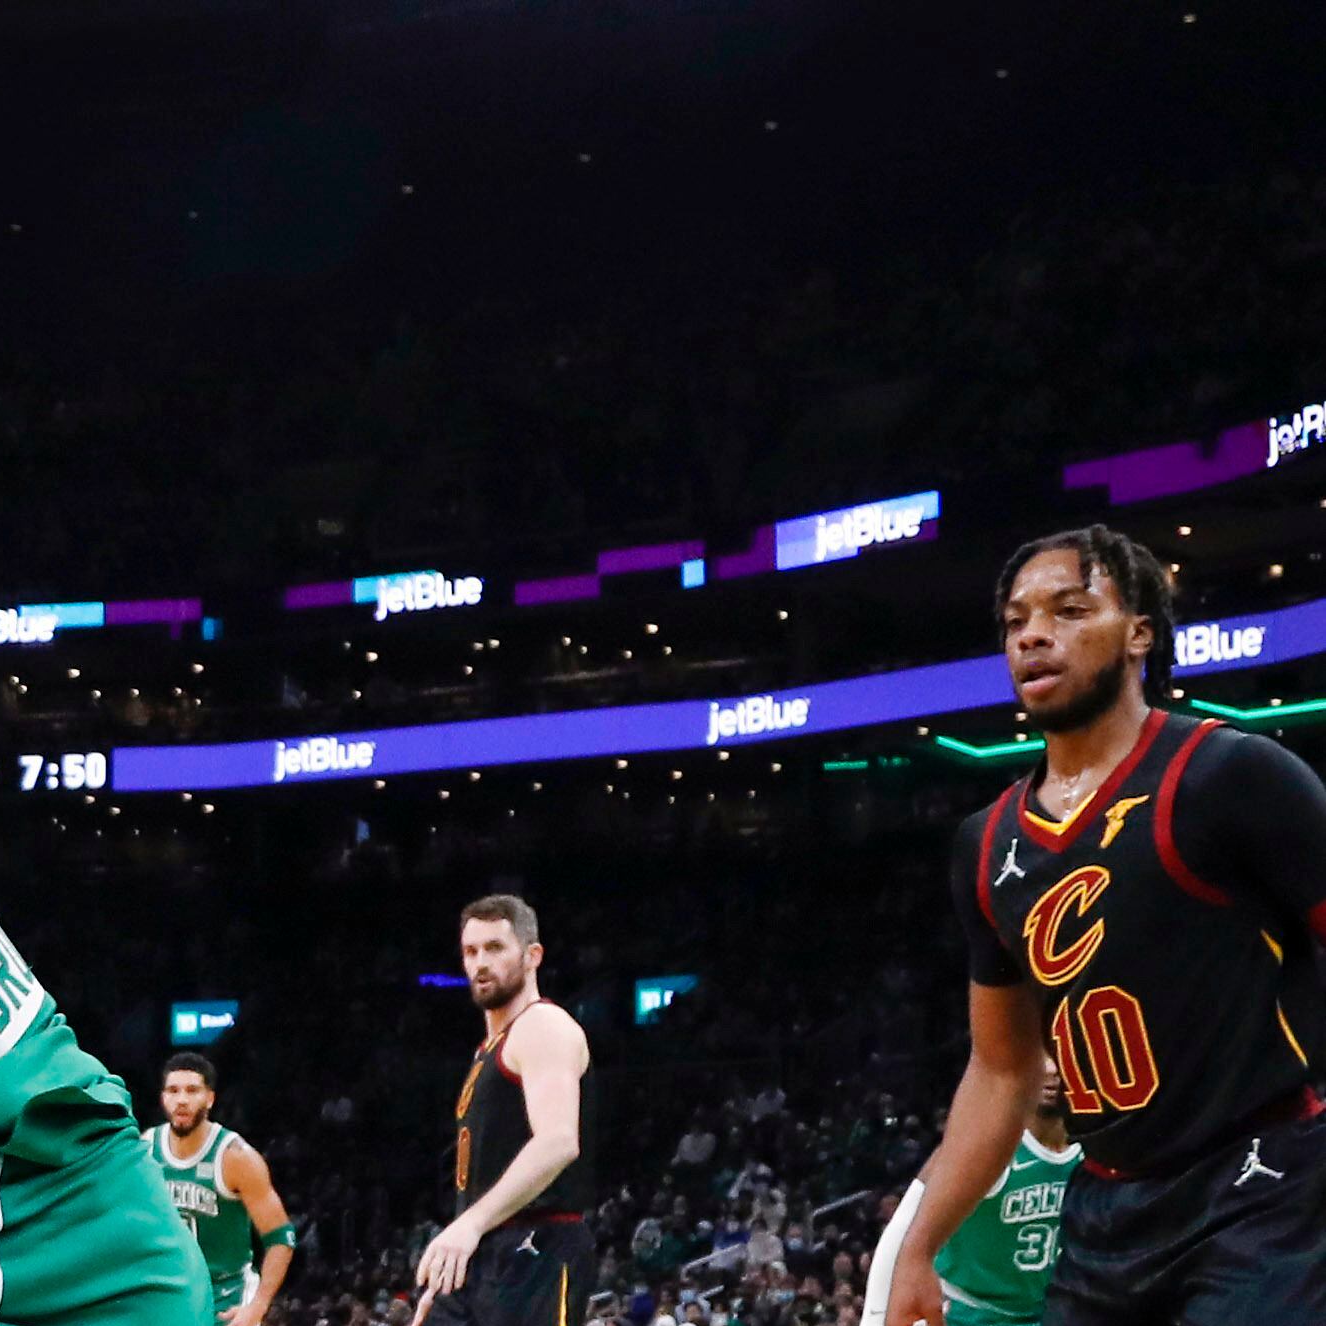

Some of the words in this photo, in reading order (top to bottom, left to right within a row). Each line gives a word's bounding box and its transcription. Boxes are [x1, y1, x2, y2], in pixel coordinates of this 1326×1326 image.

[814, 505, 923, 561] jetBlue
[373, 572, 483, 621] jetBlue
[1174, 623, 1265, 667] tBlue
[706, 695, 810, 745] jetBlue
[19, 752, 107, 792] 7:50
[273, 737, 375, 782] jetBlue
[1051, 985, 1160, 1114] 10
[1000, 1181, 1068, 1224] CELT
[1013, 1223, 1063, 1272] 3
